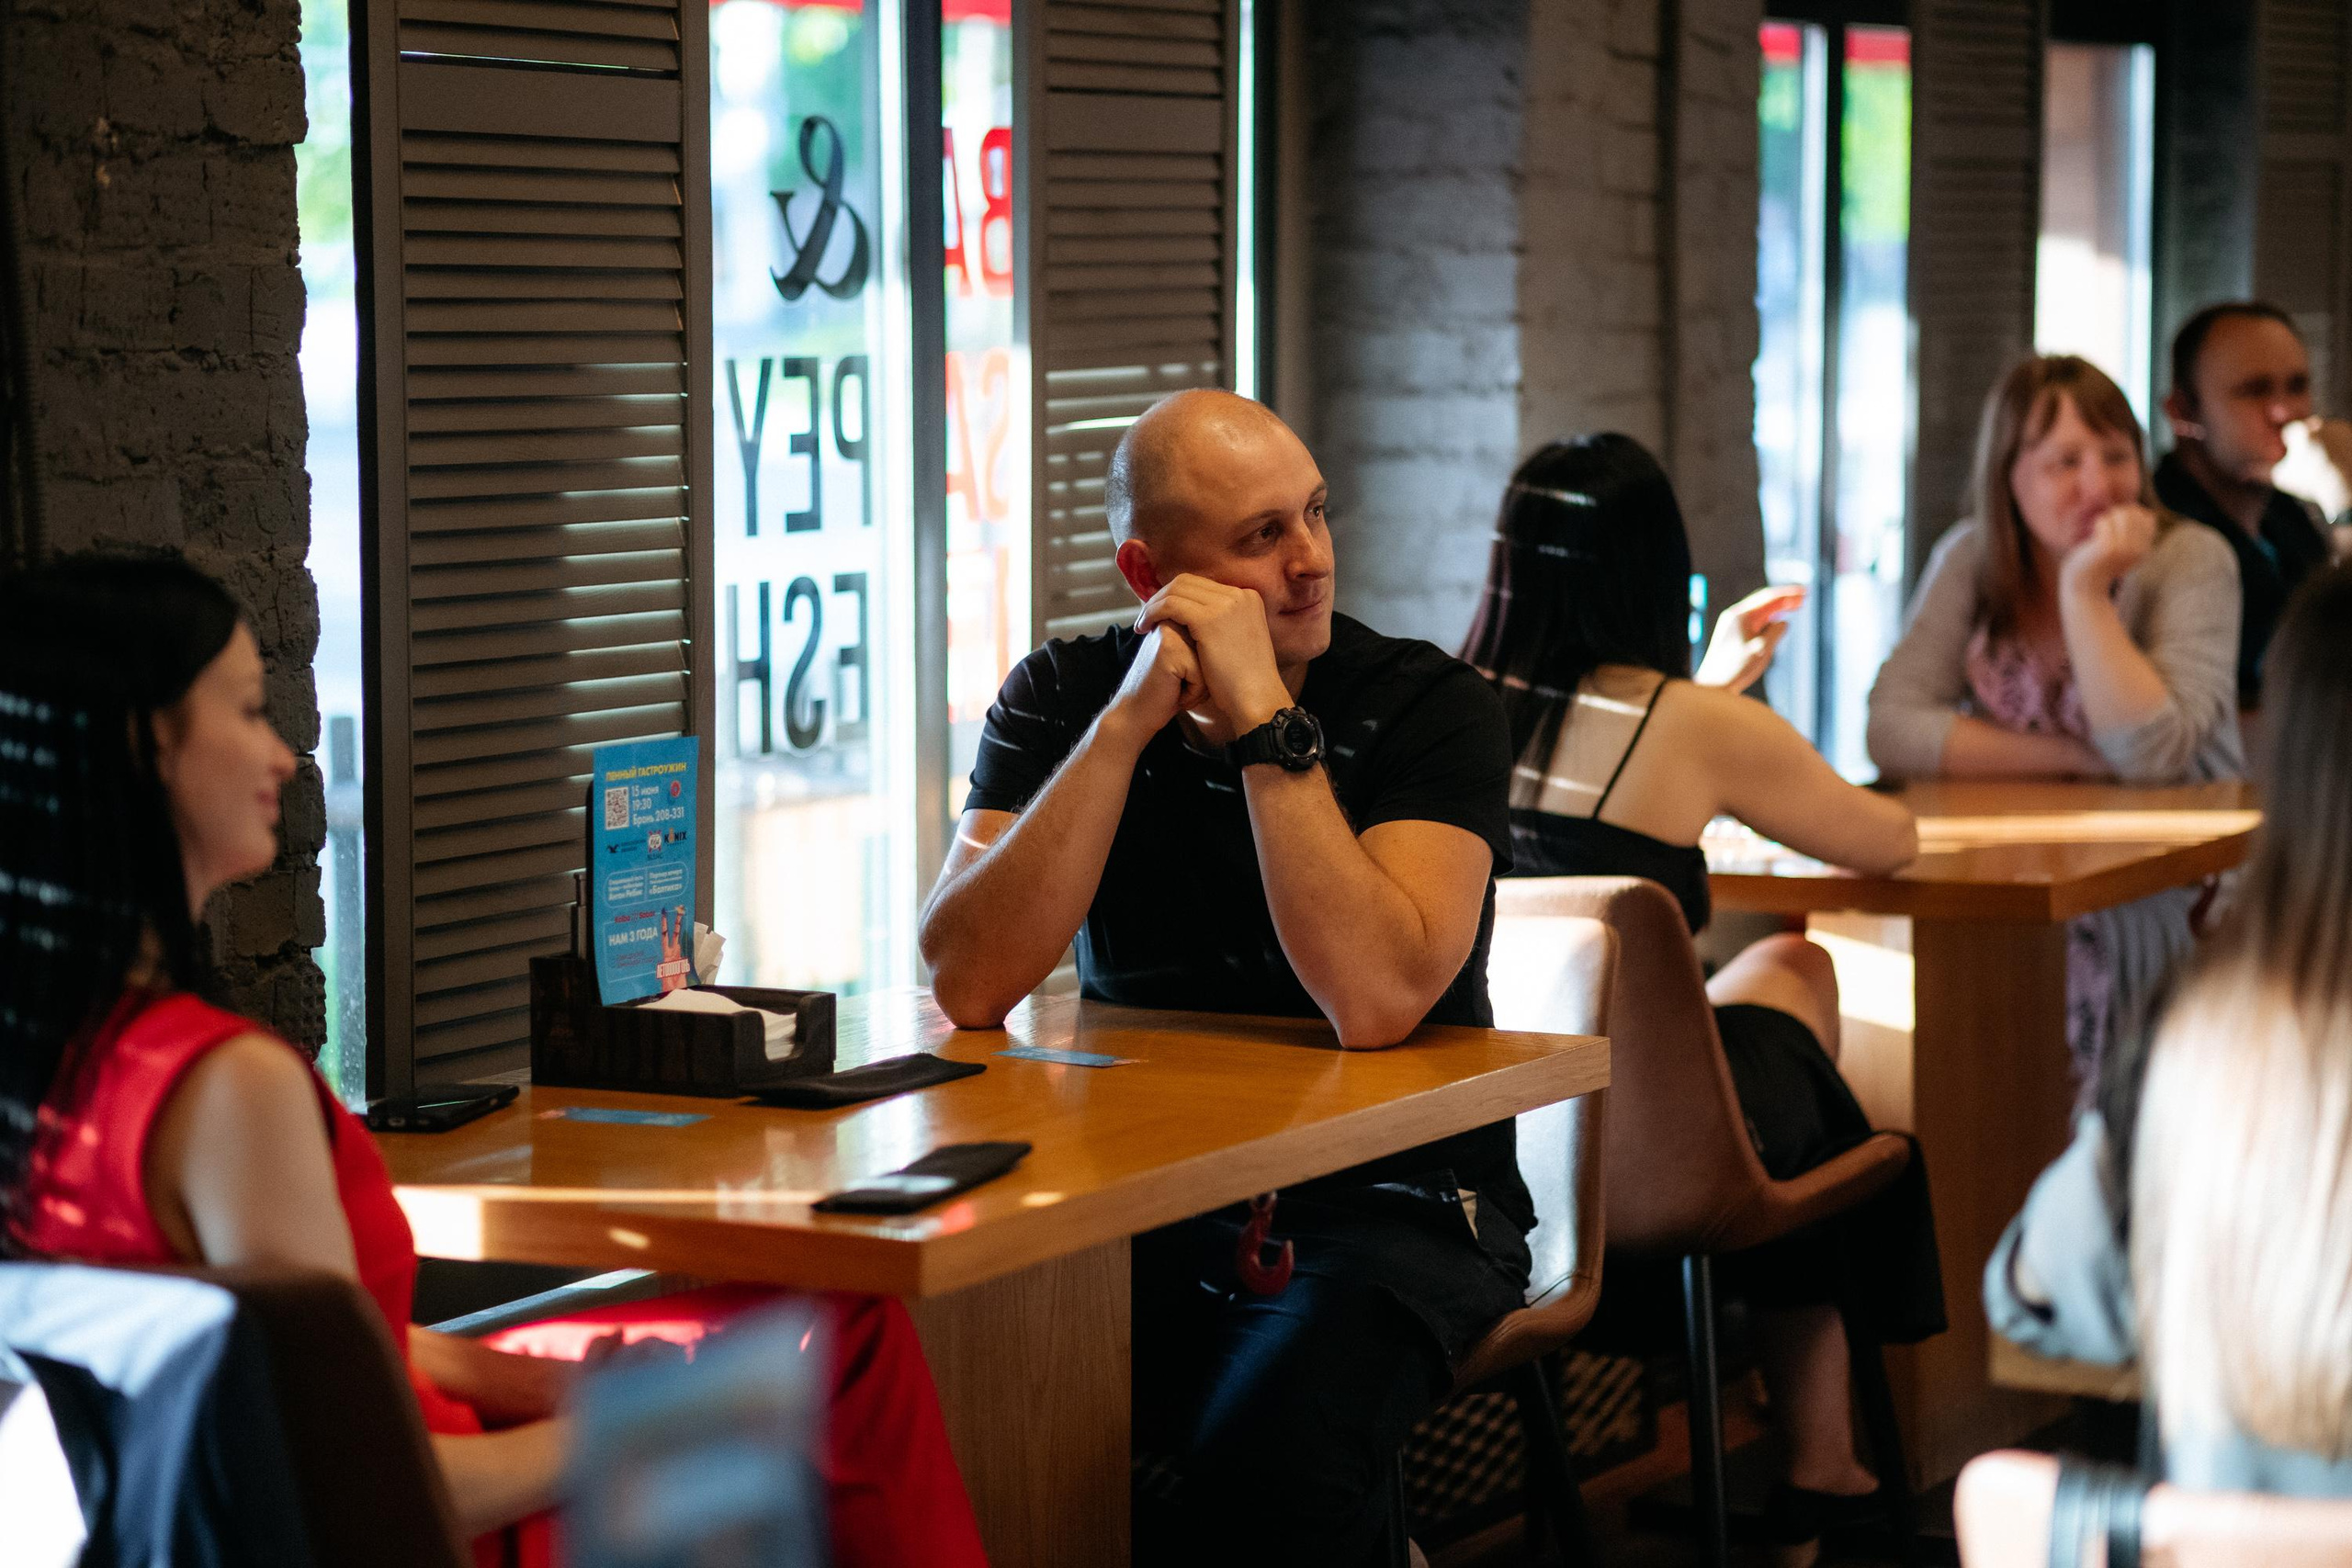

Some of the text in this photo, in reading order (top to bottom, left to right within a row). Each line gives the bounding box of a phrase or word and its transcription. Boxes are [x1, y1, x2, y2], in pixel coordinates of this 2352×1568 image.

[638, 762, 687, 777] ГАСТРОУЖИН
[631, 785, 659, 796] 15 июня
[632, 798, 651, 811] 19:30
[655, 807, 684, 822] 208-331
[609, 927, 659, 946] НАМ 3 ГОДА
